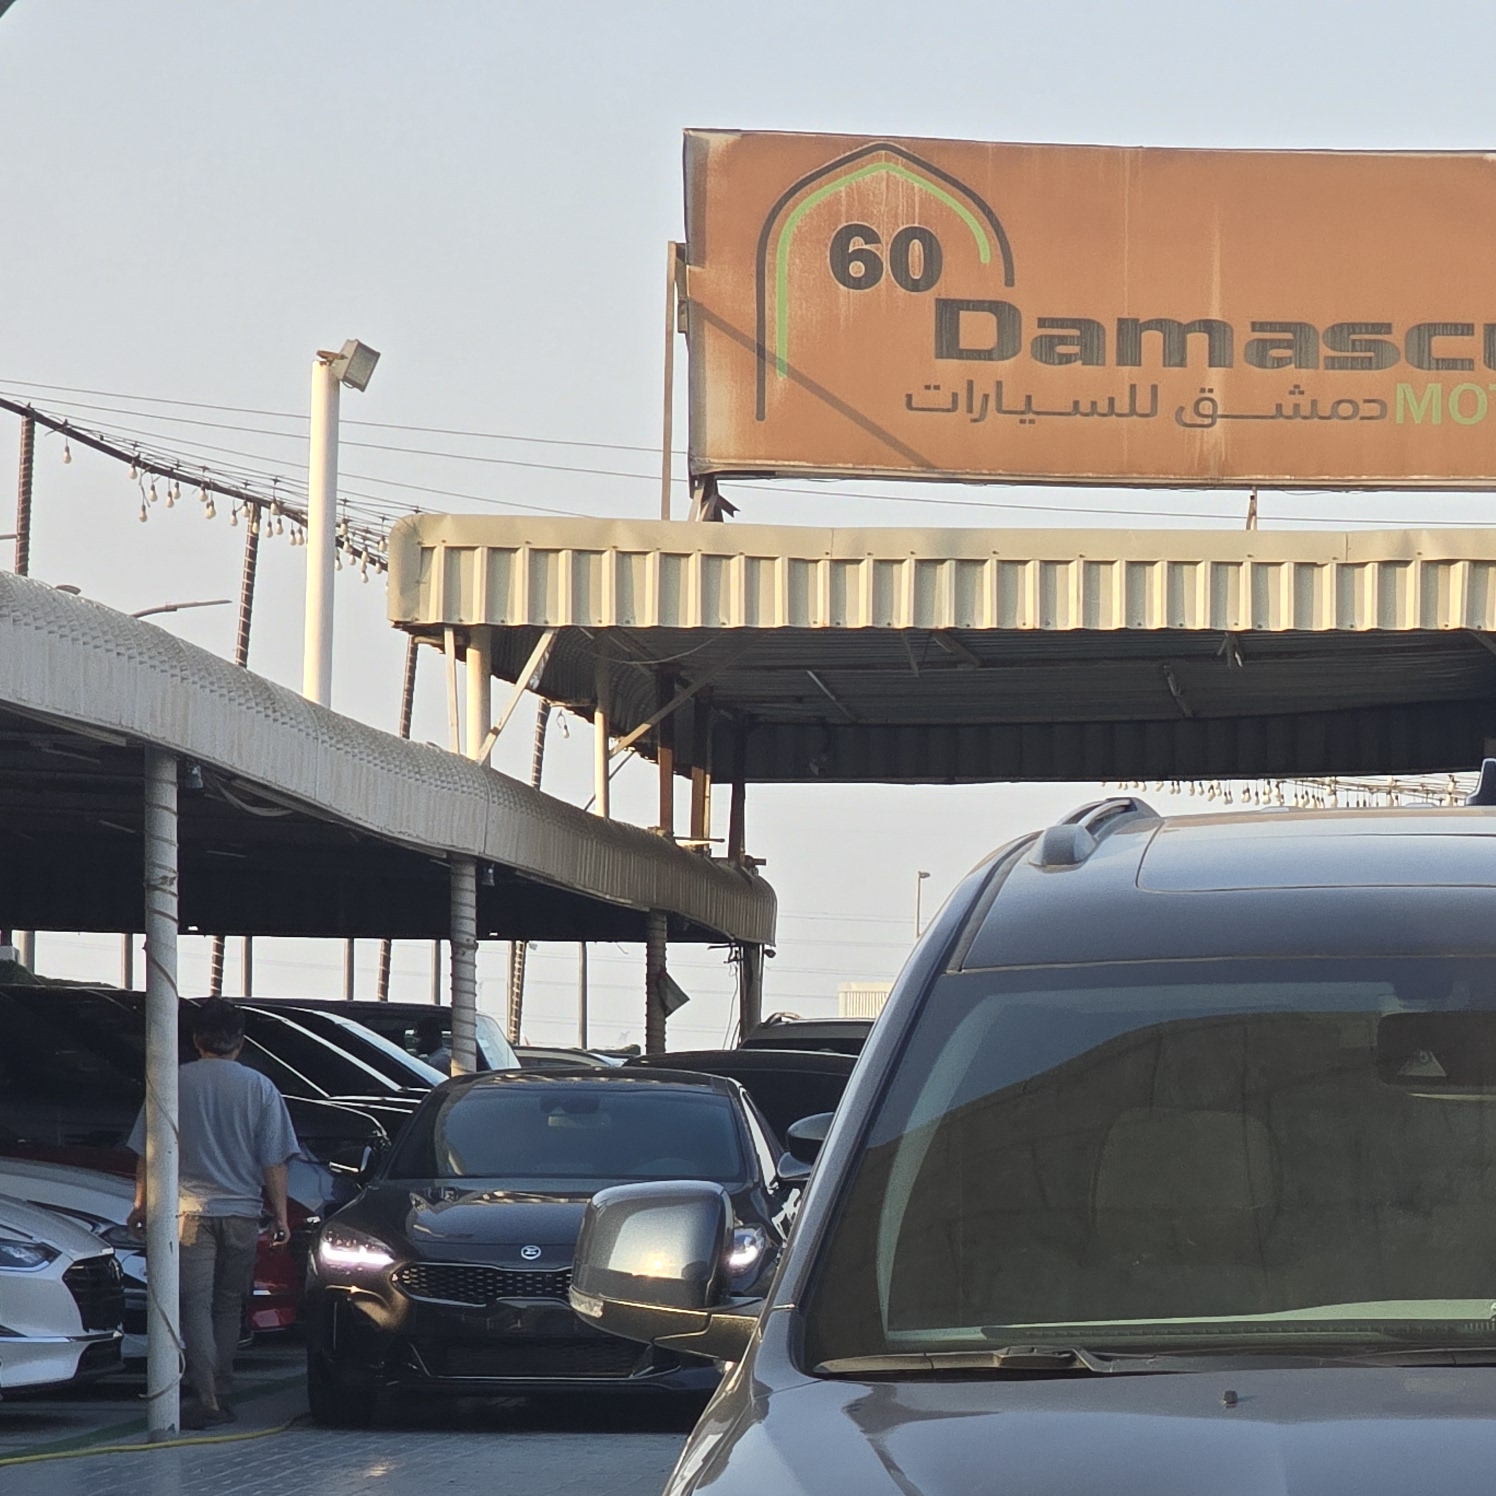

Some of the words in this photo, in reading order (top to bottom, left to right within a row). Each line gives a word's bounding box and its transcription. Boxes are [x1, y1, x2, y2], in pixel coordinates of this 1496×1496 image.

[828, 223, 944, 293] 60
[904, 379, 1160, 425] للسيارات
[1174, 384, 1389, 429] دمشق
